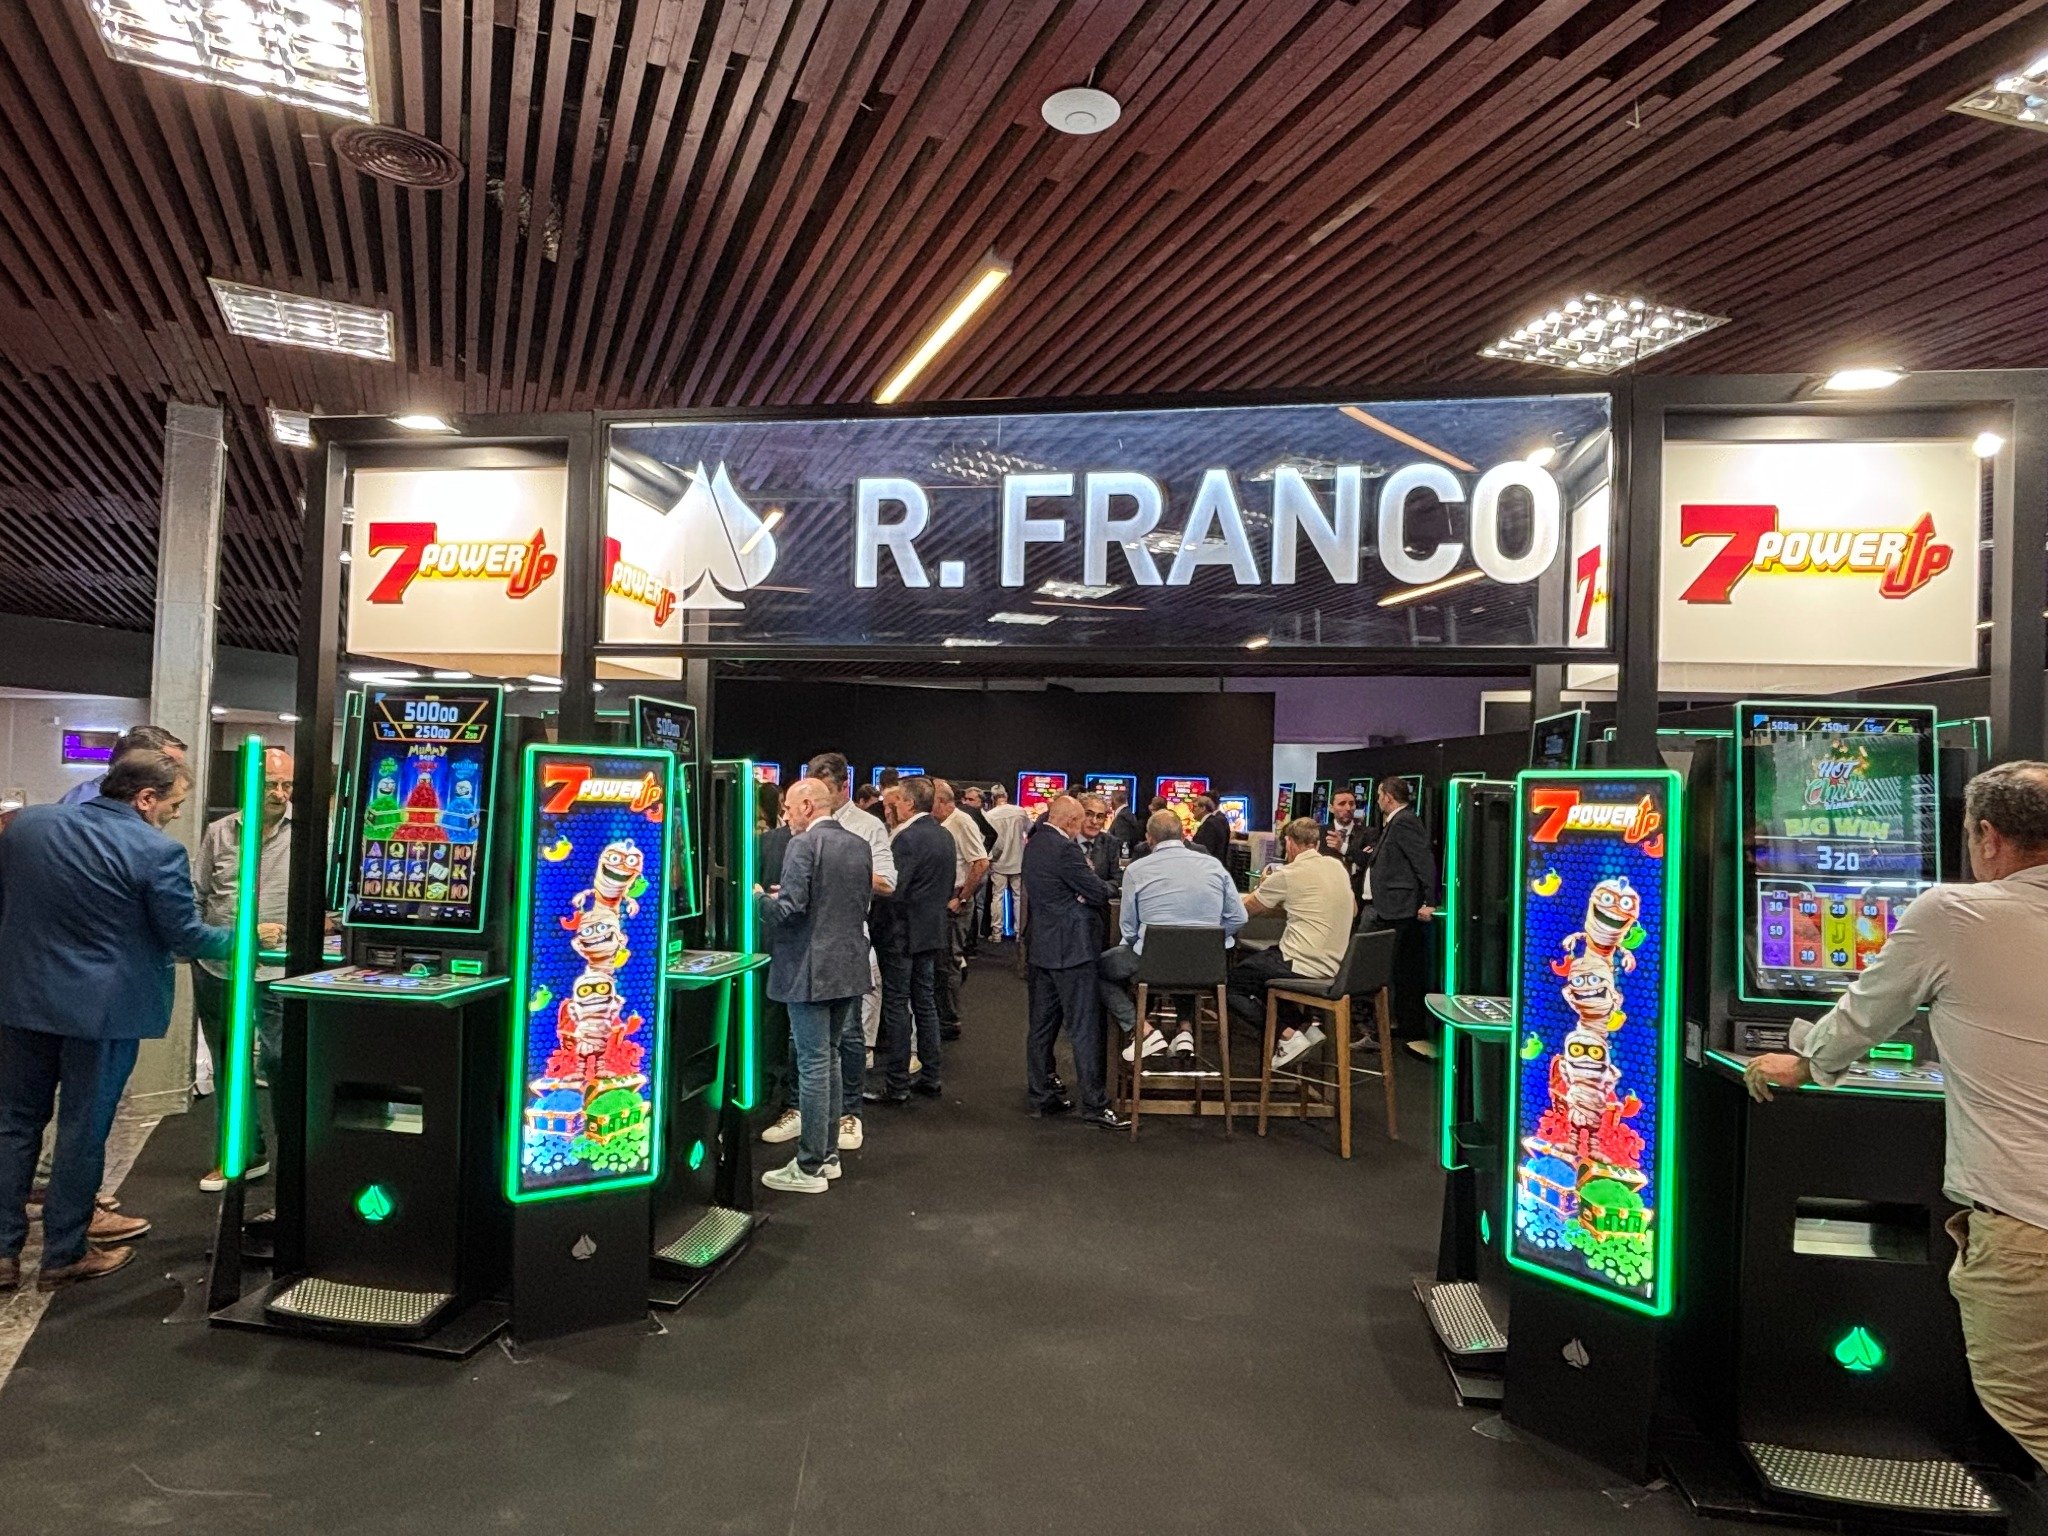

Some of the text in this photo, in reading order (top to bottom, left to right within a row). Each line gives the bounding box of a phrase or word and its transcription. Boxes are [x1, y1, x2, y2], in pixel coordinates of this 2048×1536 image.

[854, 460, 1562, 589] R. FRANCO
[367, 522, 437, 604] 7
[418, 543, 528, 578] POWER
[1679, 504, 1778, 604] 7
[1743, 531, 1908, 572] POWER
[543, 764, 592, 813] 7
[578, 779, 644, 802] POWER
[1532, 789, 1580, 842] 7
[1566, 804, 1640, 830] POWER
[1784, 817, 1890, 840] BIG WIN
[1817, 845, 1860, 871] 320
